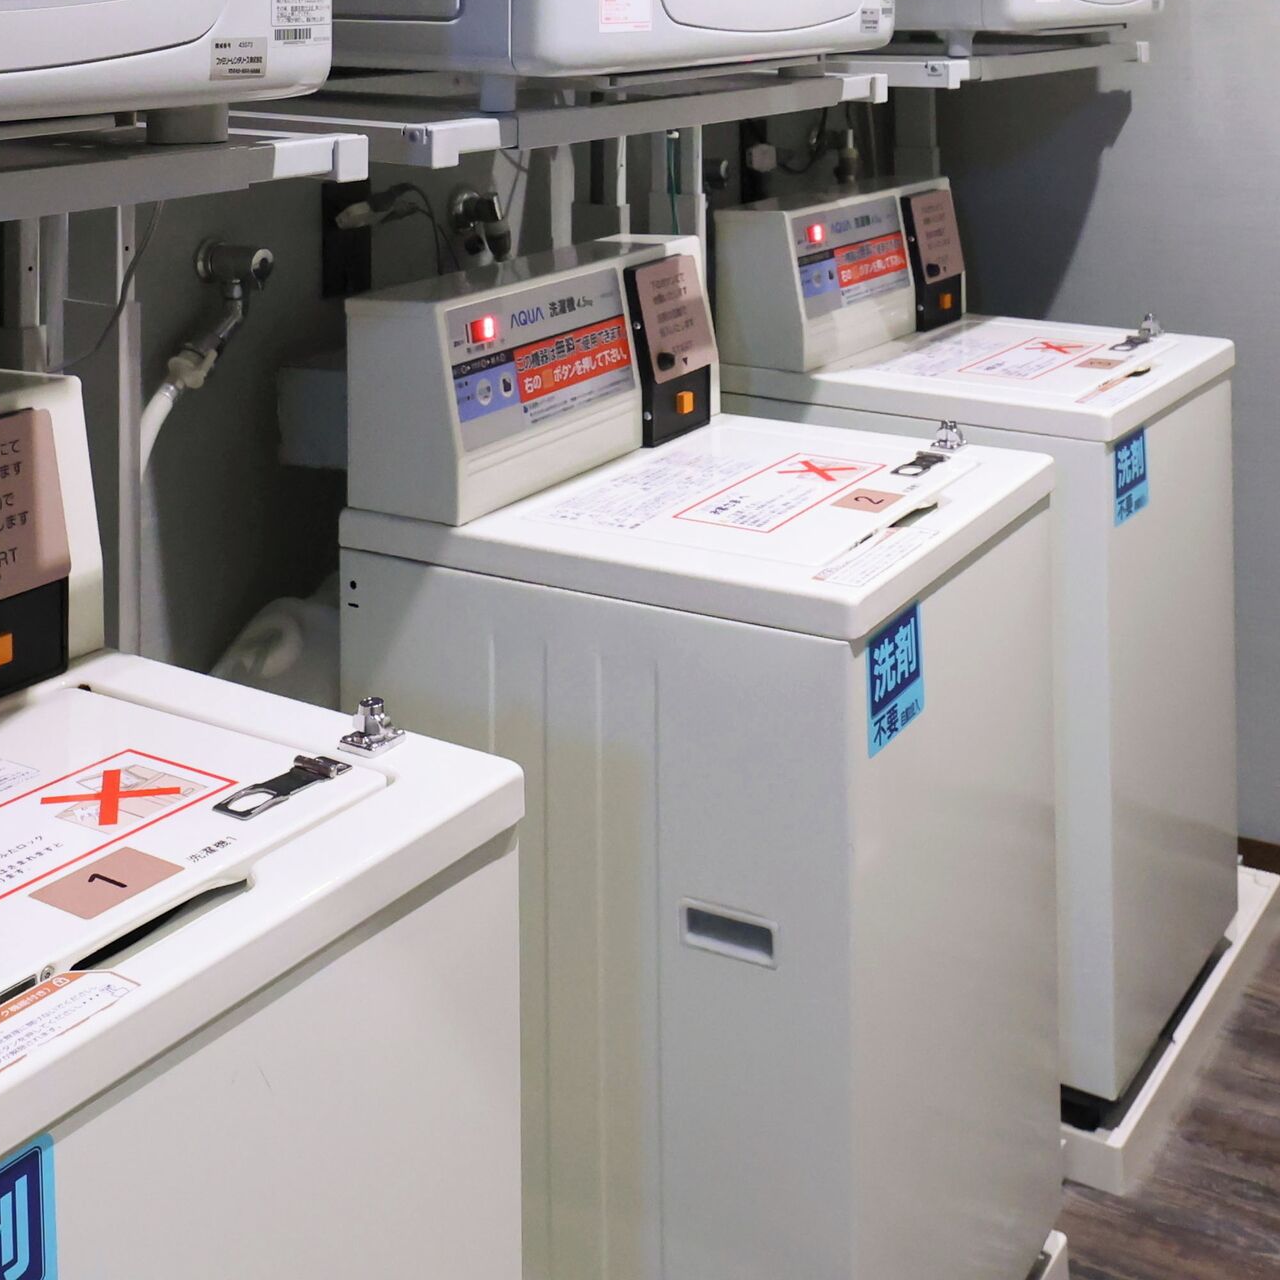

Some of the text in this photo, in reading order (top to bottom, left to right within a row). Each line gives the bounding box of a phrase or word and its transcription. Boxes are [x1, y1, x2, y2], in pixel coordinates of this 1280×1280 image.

[510, 307, 544, 328] AQUA
[1118, 436, 1144, 488] 洗剤
[874, 617, 916, 702] 洗剤
[874, 703, 898, 746] 不要
[187, 836, 237, 863] 洗濯機1
[88, 873, 127, 888] 1
